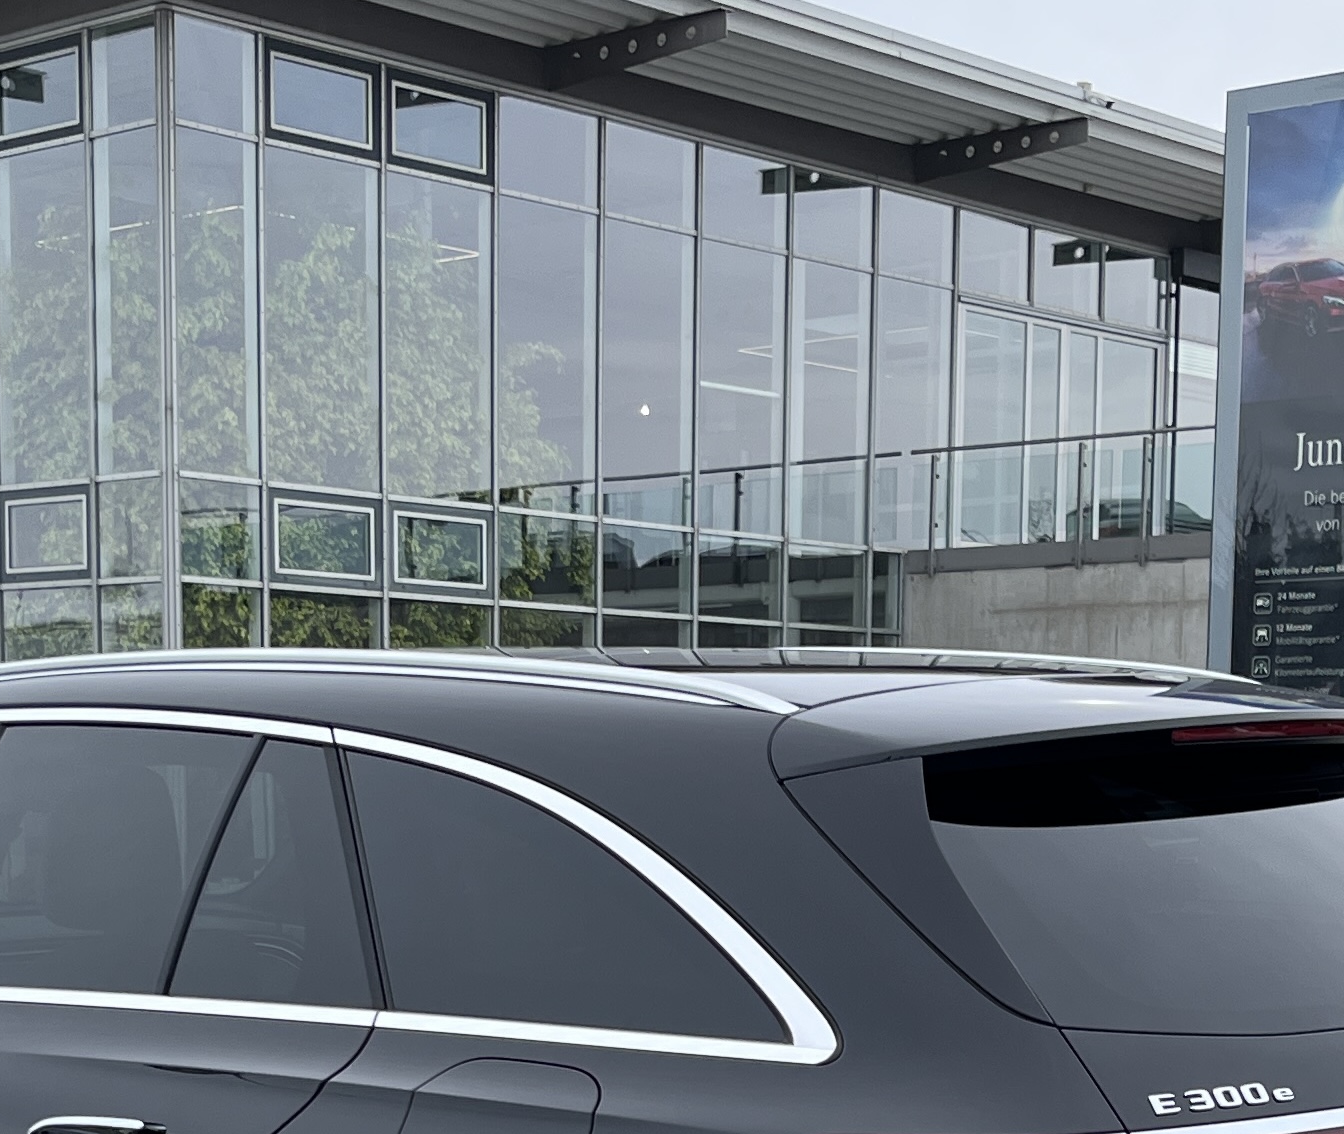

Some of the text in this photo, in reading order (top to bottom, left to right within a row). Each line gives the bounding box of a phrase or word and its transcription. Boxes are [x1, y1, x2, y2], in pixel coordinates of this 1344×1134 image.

[1304, 490, 1327, 506] Die
[1316, 517, 1340, 532] von
[1271, 566, 1300, 576] Vorteile
[1300, 565, 1314, 575] auf
[1277, 591, 1316, 601] 24 Monate
[1276, 623, 1313, 633] 12 Monate
[1147, 1082, 1295, 1116] E 300 e
